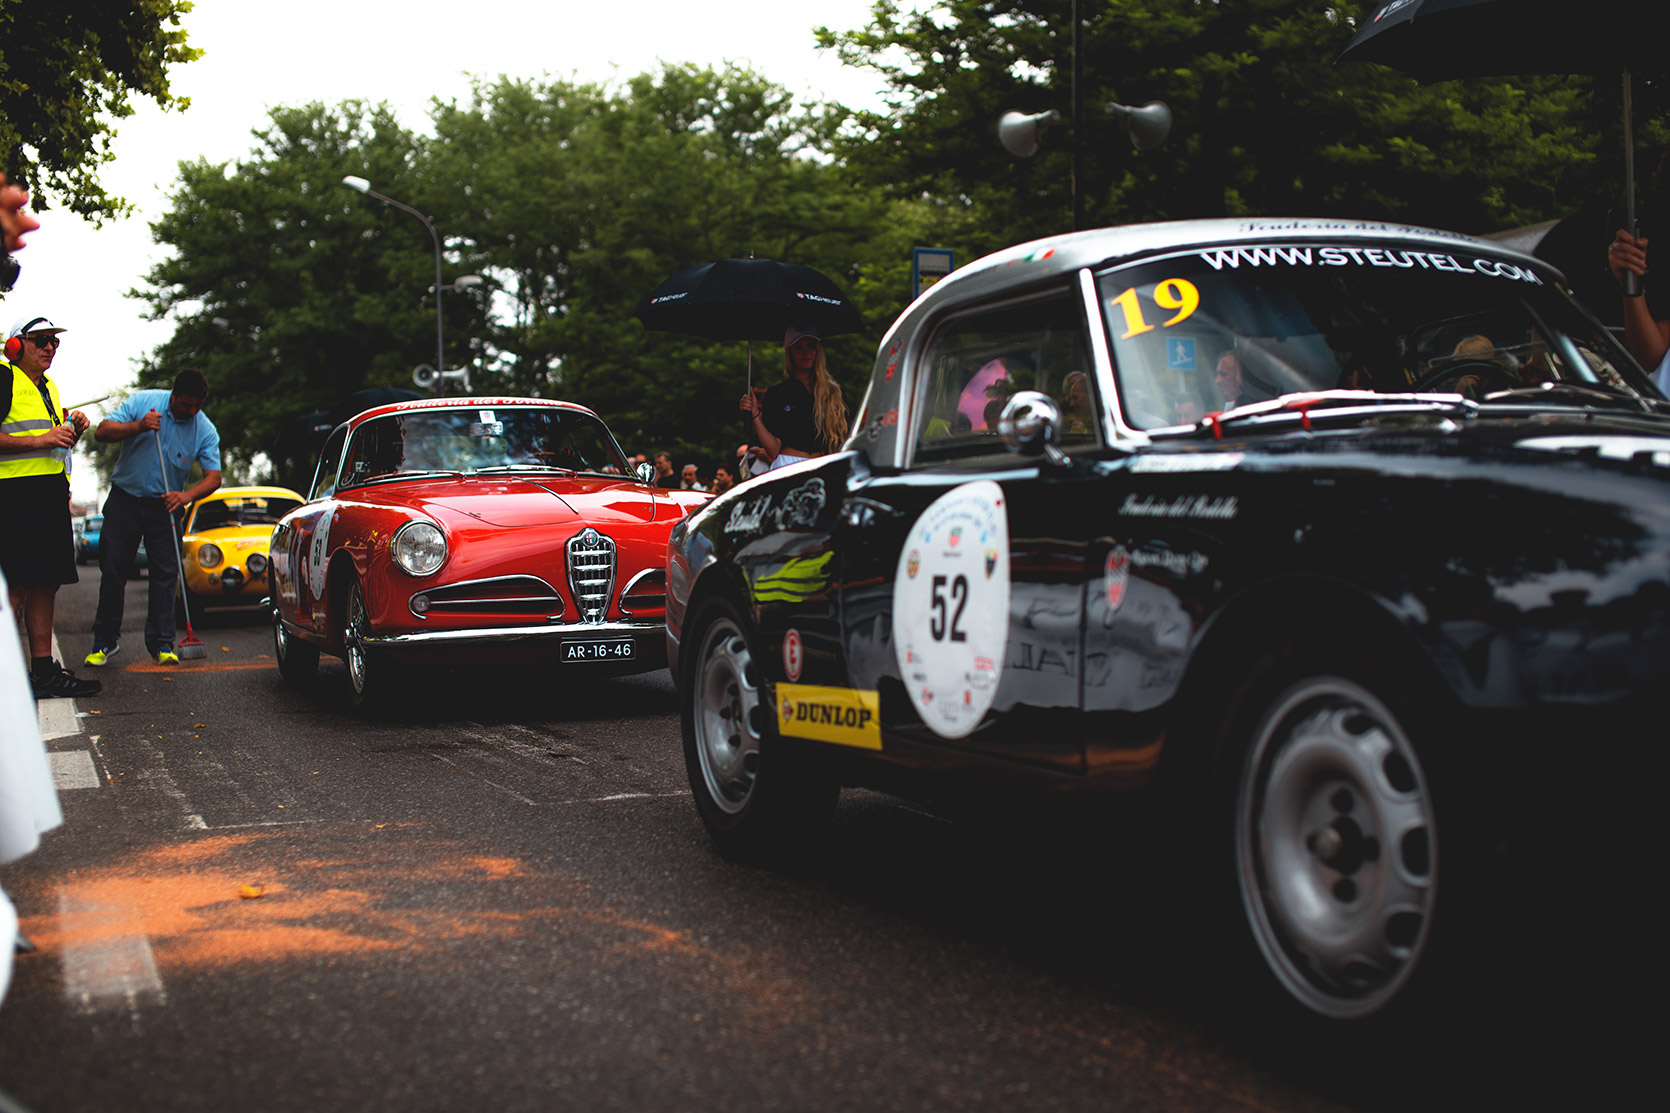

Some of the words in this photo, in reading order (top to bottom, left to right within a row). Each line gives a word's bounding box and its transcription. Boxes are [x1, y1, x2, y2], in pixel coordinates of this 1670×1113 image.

[1110, 277, 1200, 340] 19
[314, 538, 323, 567] 53
[929, 573, 969, 643] 52
[567, 643, 631, 659] AR-16-46
[796, 701, 872, 729] DUNLOP
